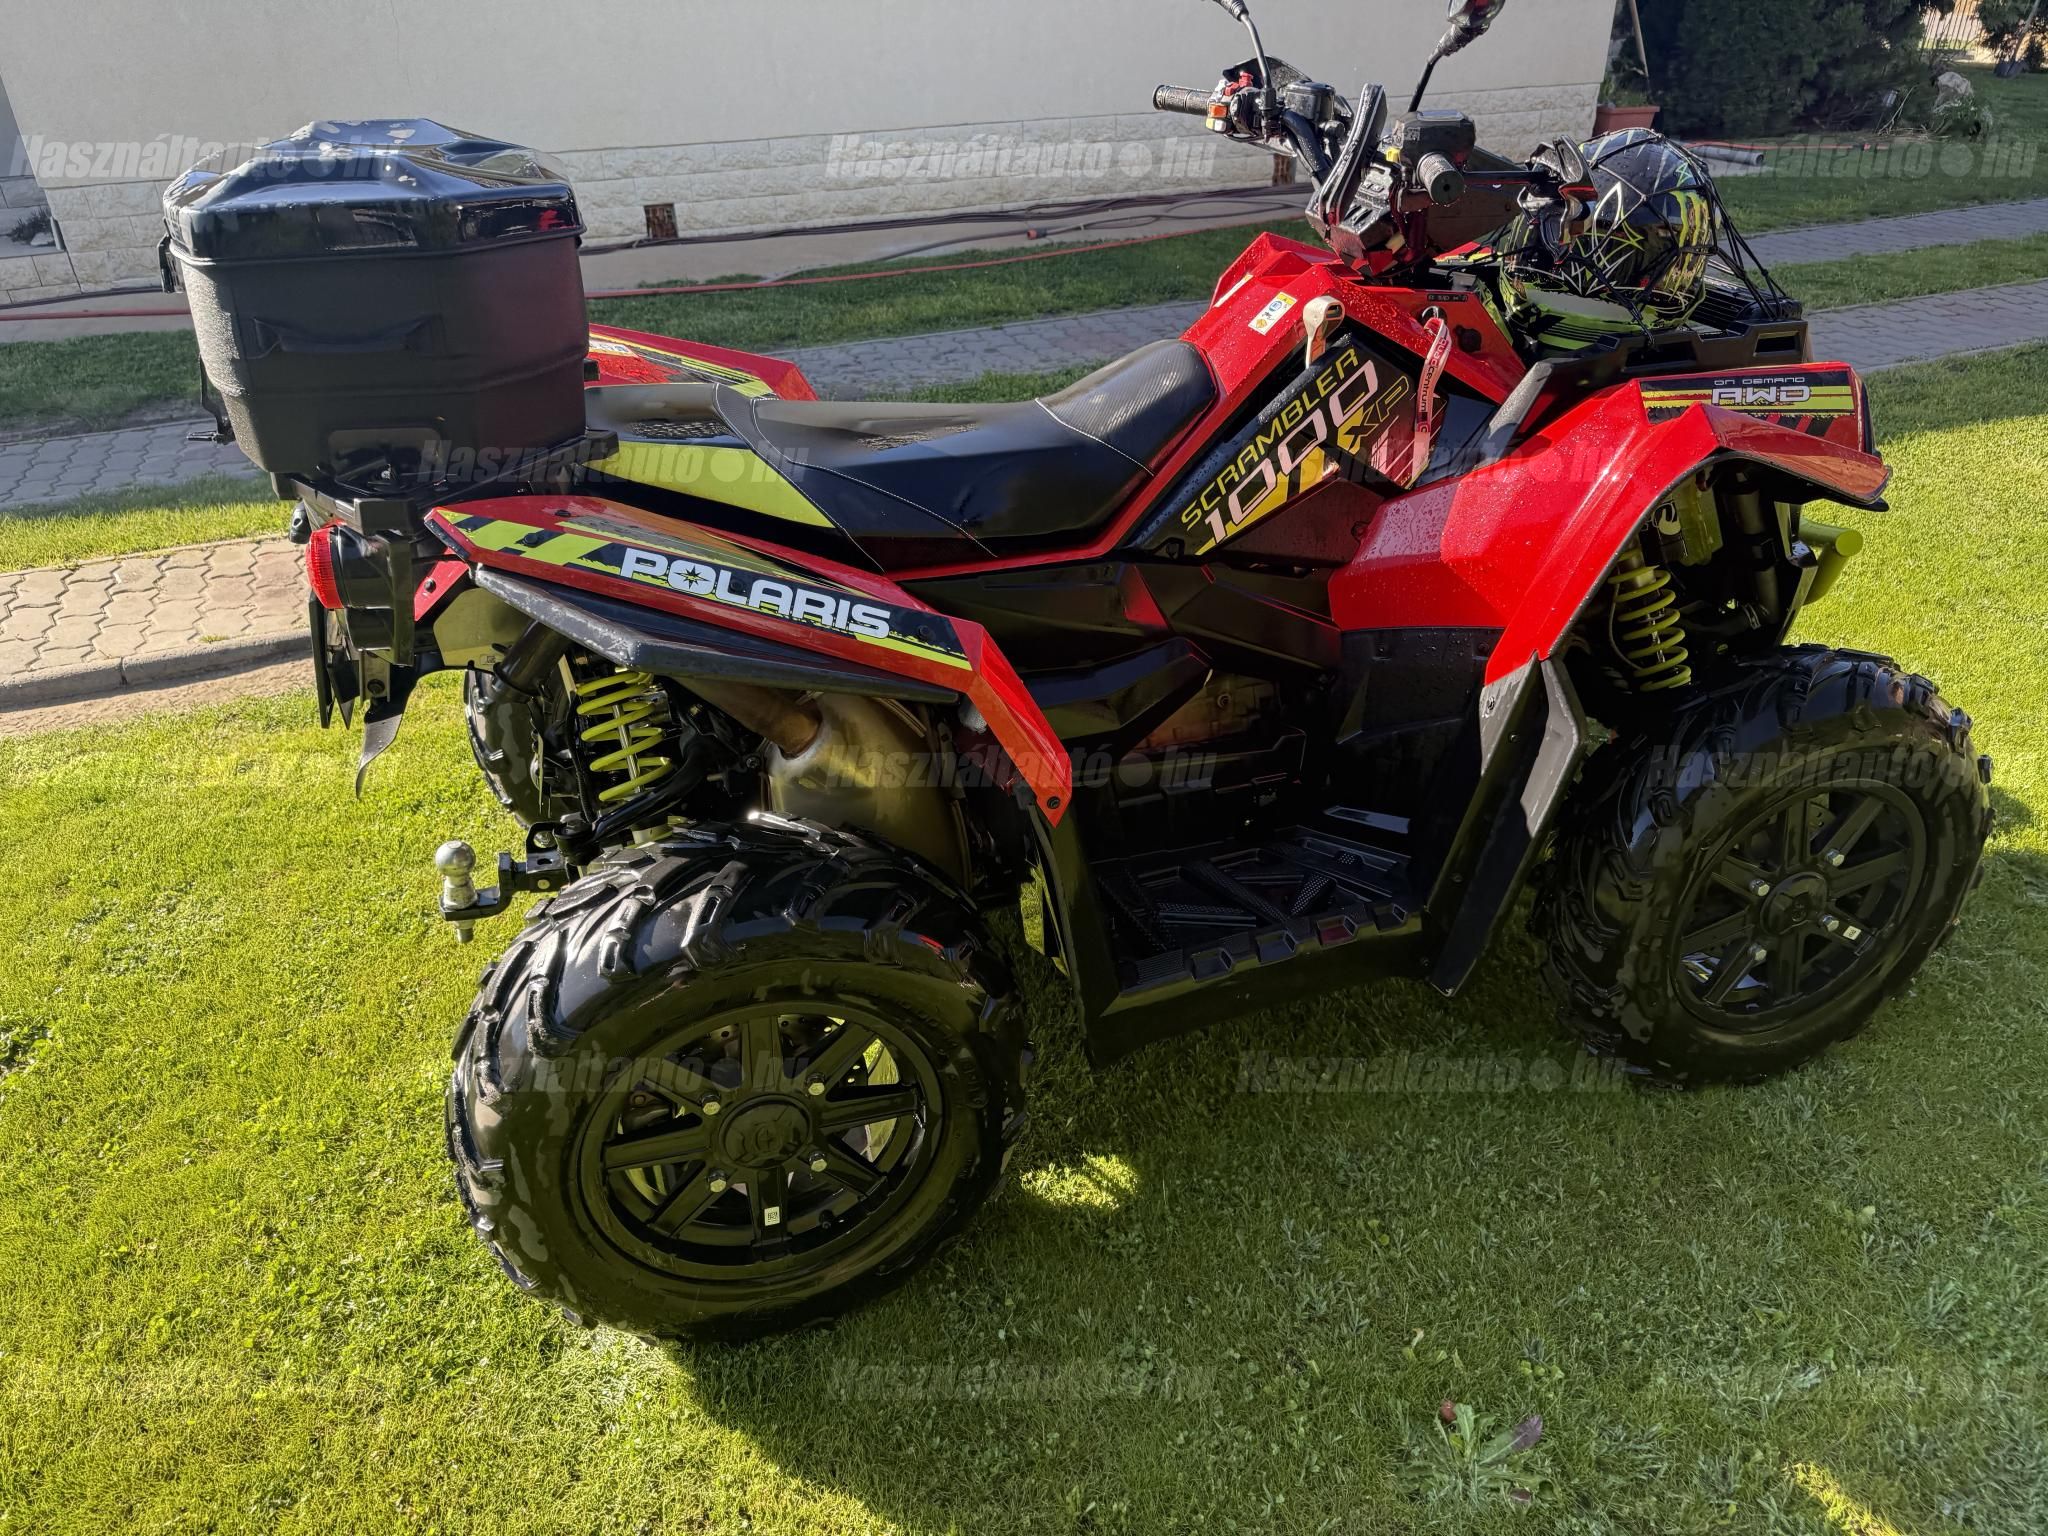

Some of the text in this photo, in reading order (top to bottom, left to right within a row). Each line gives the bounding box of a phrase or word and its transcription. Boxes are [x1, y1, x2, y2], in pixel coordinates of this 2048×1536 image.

[1711, 385, 1812, 405] AWD
[1742, 376, 1805, 385] DEMAND
[1181, 349, 1359, 532] SCRAMBLER
[1205, 360, 1379, 544] 1000
[620, 546, 891, 639] POLARIS
